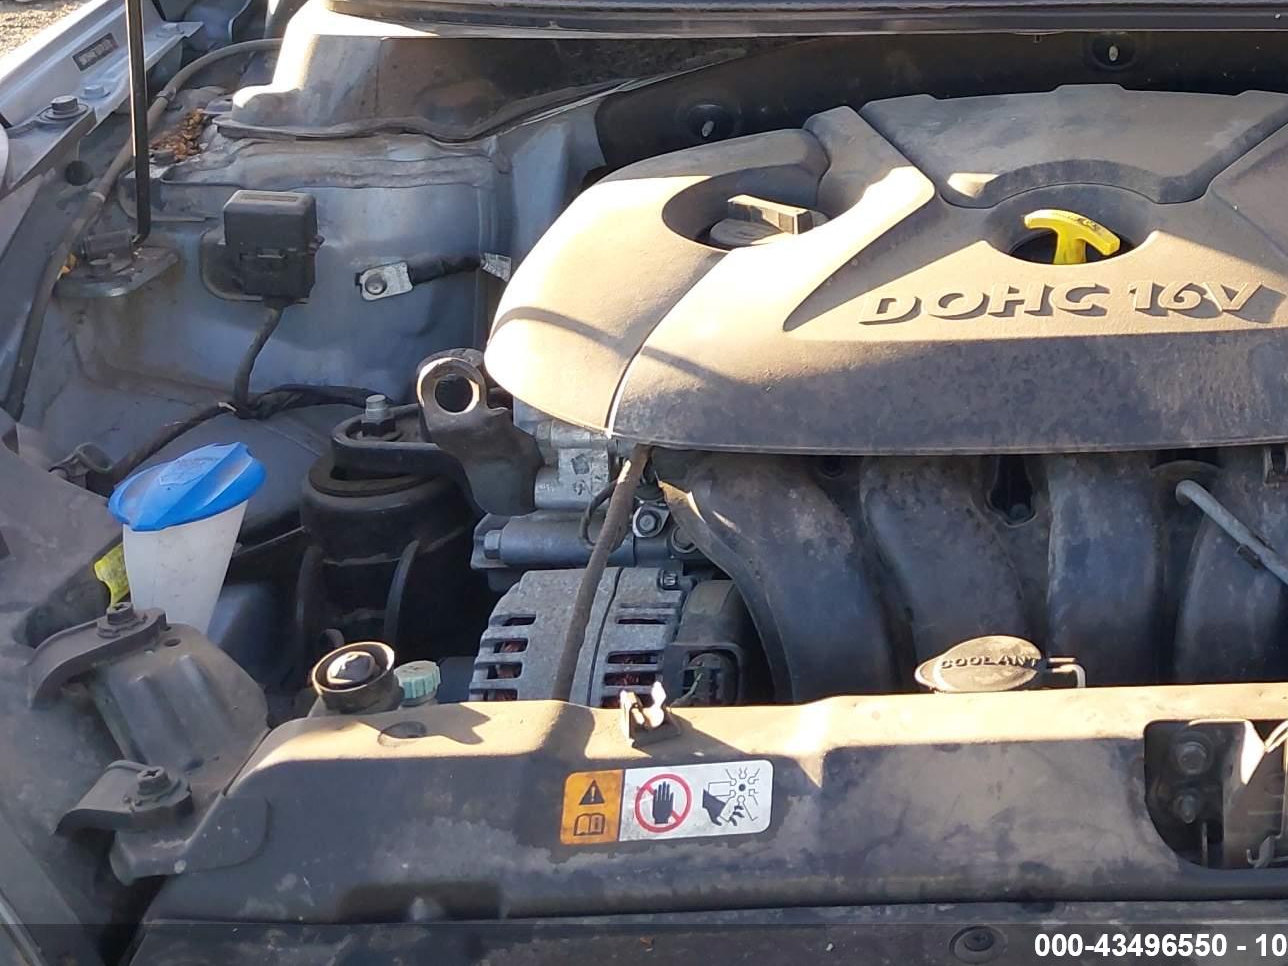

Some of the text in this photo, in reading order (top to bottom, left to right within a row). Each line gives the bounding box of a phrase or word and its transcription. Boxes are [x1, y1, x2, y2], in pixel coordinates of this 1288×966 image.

[858, 280, 1268, 325] DOHC 16V
[940, 655, 1038, 669] COOLANT
